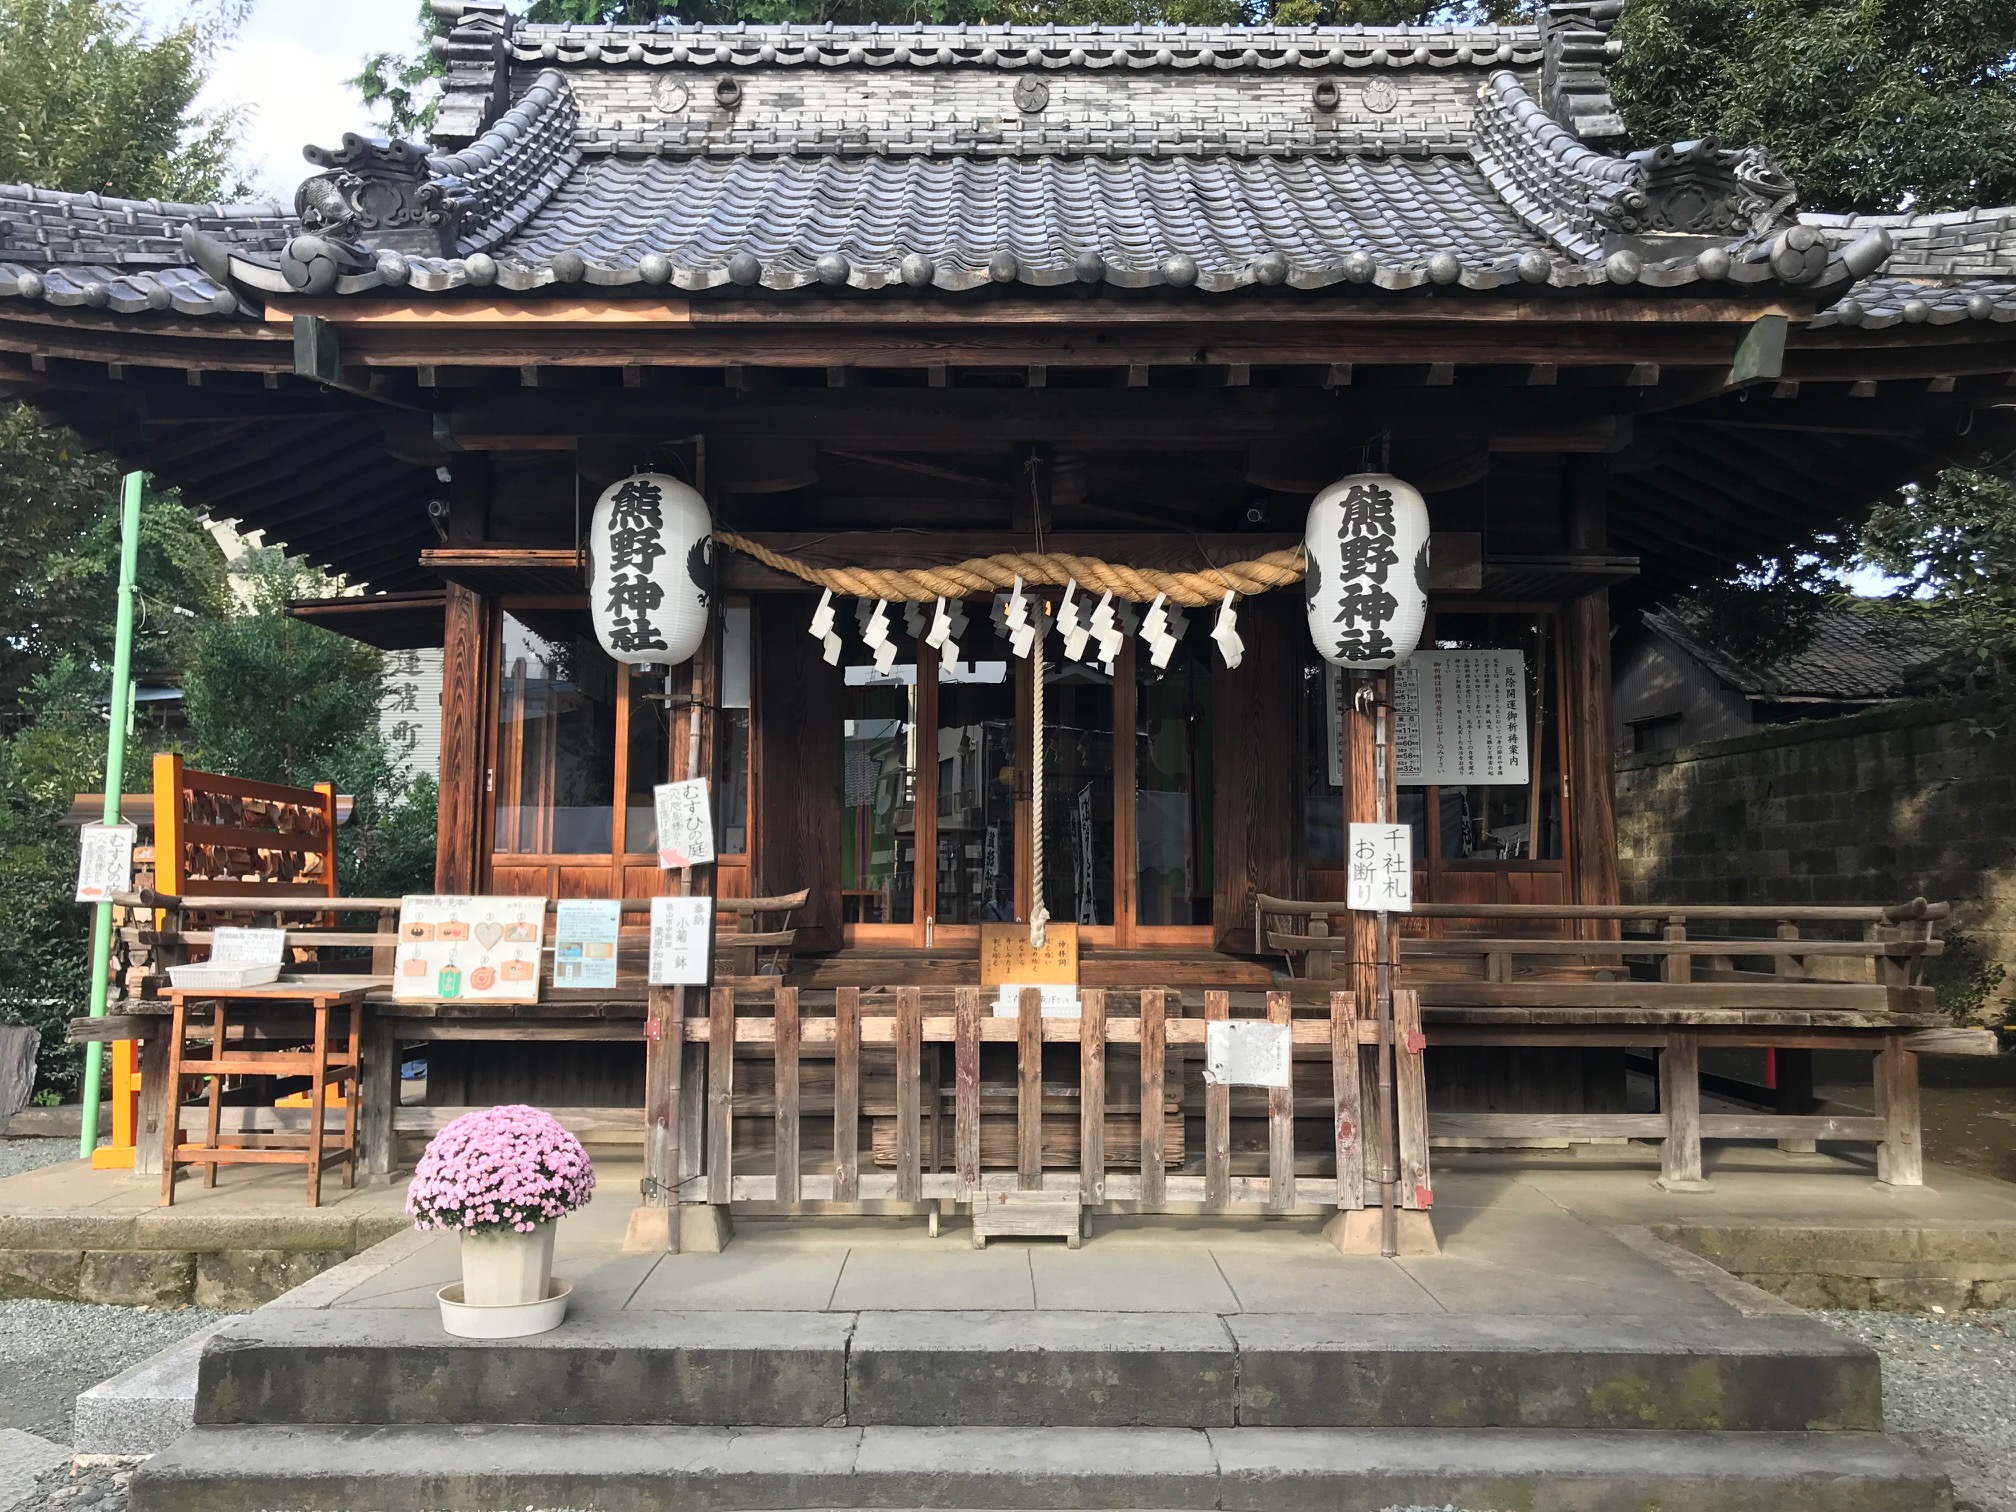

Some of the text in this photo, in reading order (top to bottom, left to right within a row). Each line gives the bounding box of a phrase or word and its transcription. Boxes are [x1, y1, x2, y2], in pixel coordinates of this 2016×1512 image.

[605, 480, 668, 652] 熊野神社
[1332, 484, 1399, 662] 熊野神社
[683, 784, 707, 858] むすひの庭
[1354, 838, 1377, 906] お断り
[1382, 828, 1407, 898] 千社札
[675, 916, 689, 969] 小菊一鉢
[693, 903, 705, 926] 奉納
